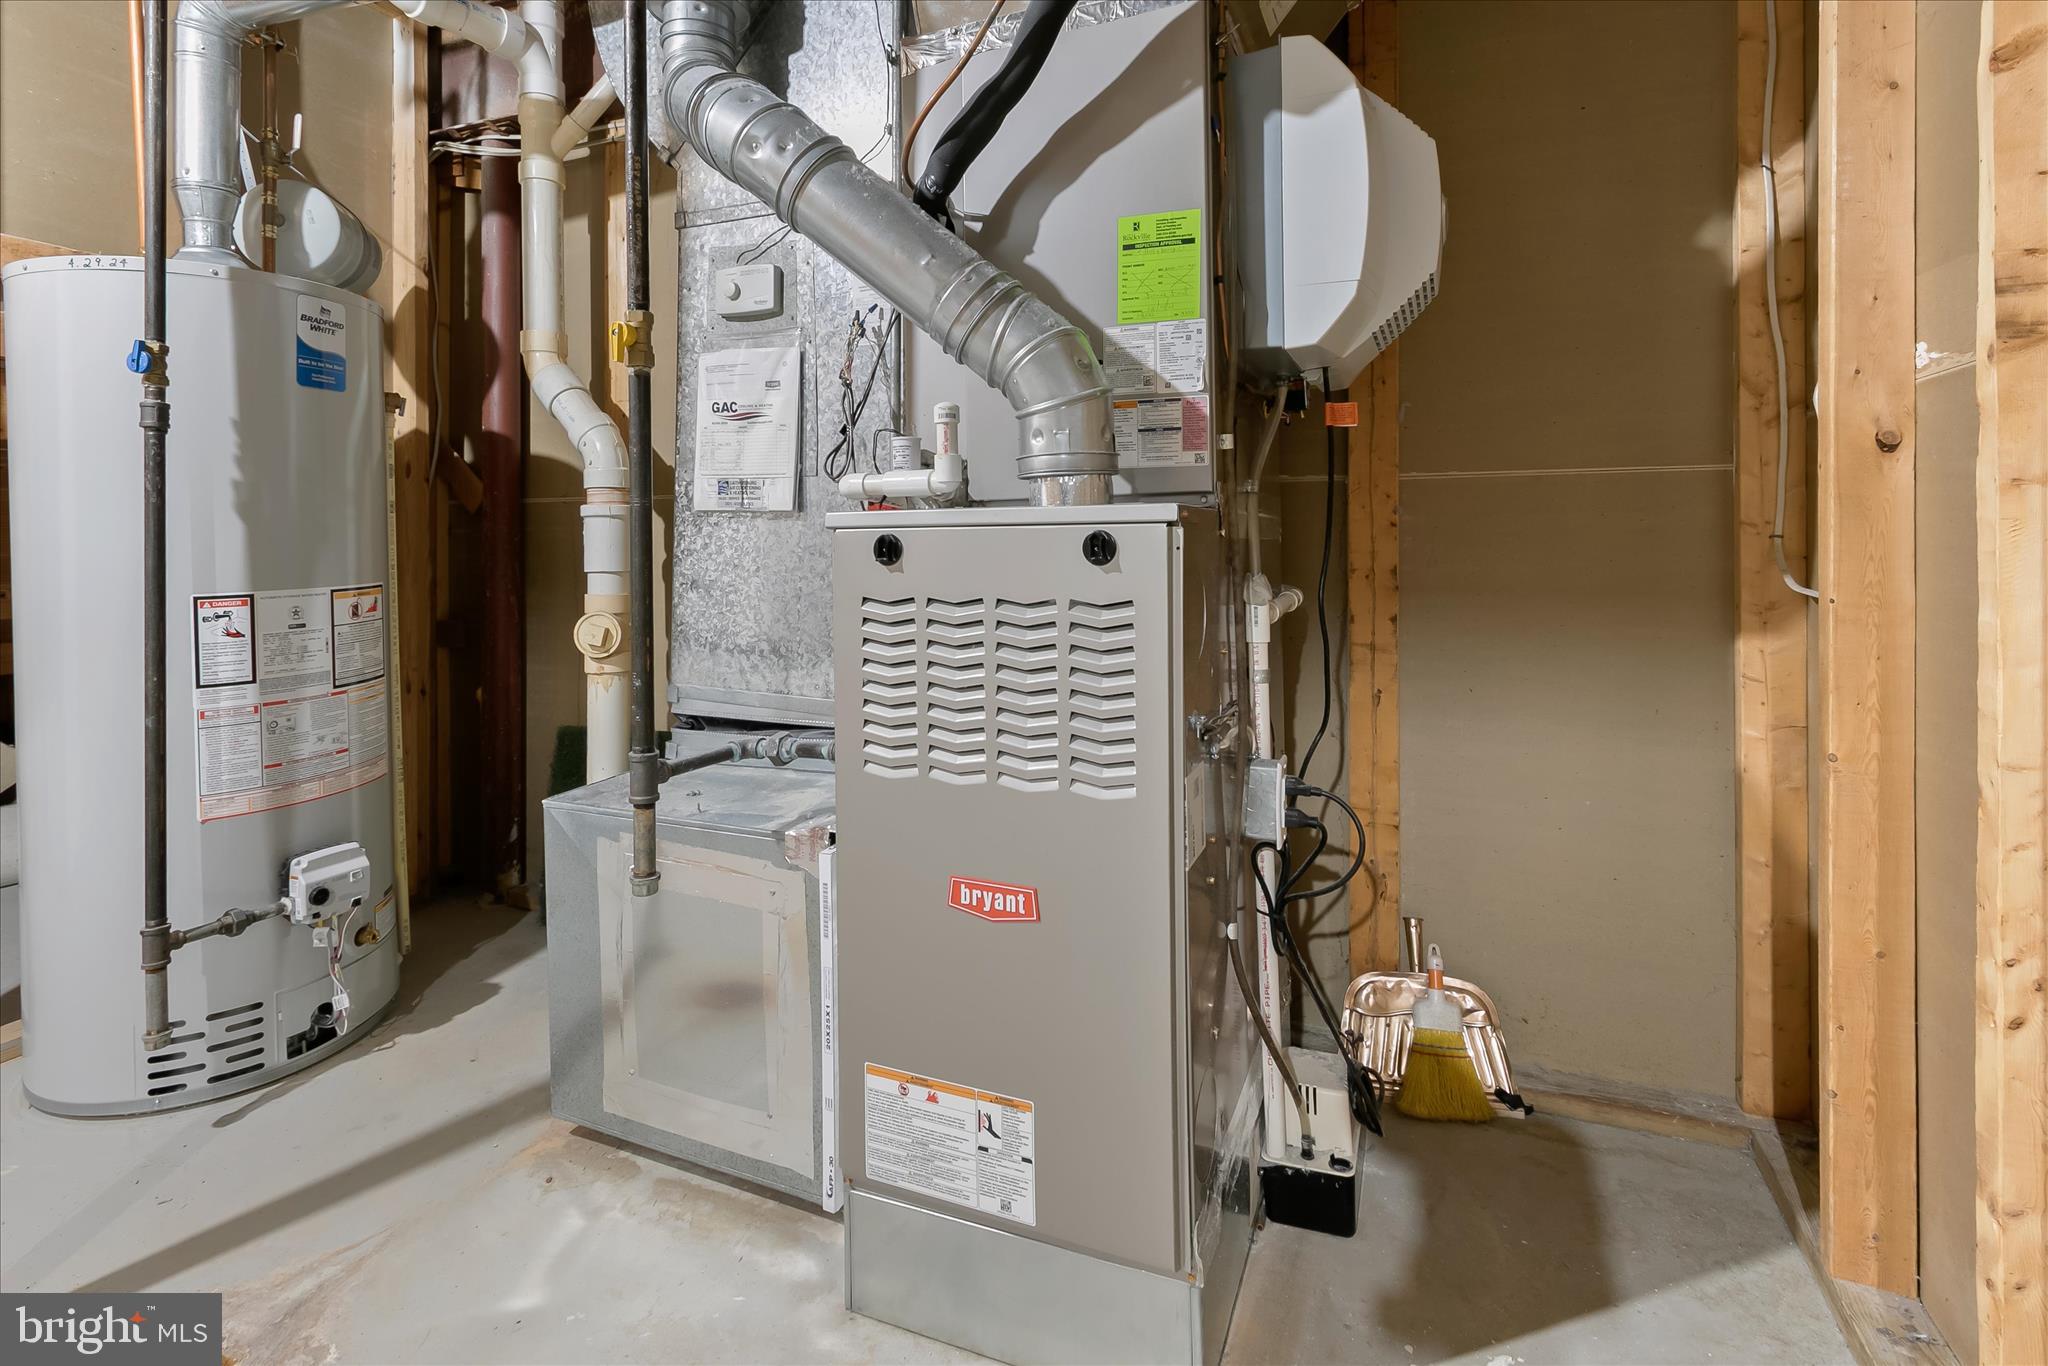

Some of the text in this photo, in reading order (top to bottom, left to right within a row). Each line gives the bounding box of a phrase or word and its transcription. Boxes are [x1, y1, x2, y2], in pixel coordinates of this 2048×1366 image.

[300, 313, 345, 330] BRADFORD
[309, 323, 337, 336] WHITE
[711, 401, 738, 413] GAC
[960, 883, 1025, 915] bryant
